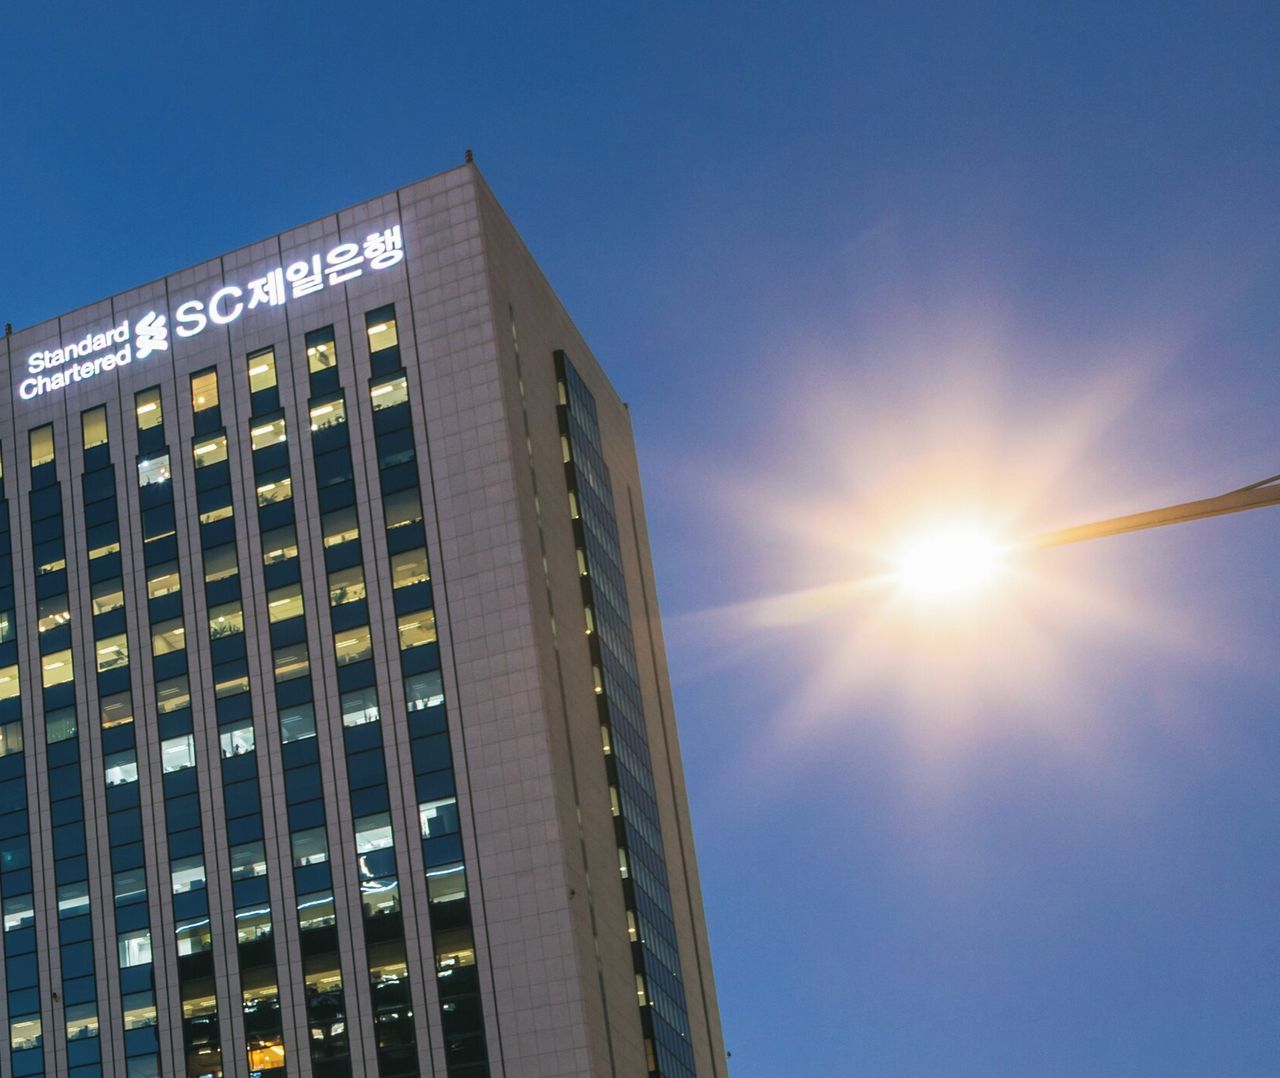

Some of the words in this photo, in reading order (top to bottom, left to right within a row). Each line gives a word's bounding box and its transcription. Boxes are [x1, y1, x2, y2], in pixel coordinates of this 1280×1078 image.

[175, 224, 404, 338] SC제일은행
[19, 343, 132, 400] Chartered
[27, 320, 130, 374] Standard
